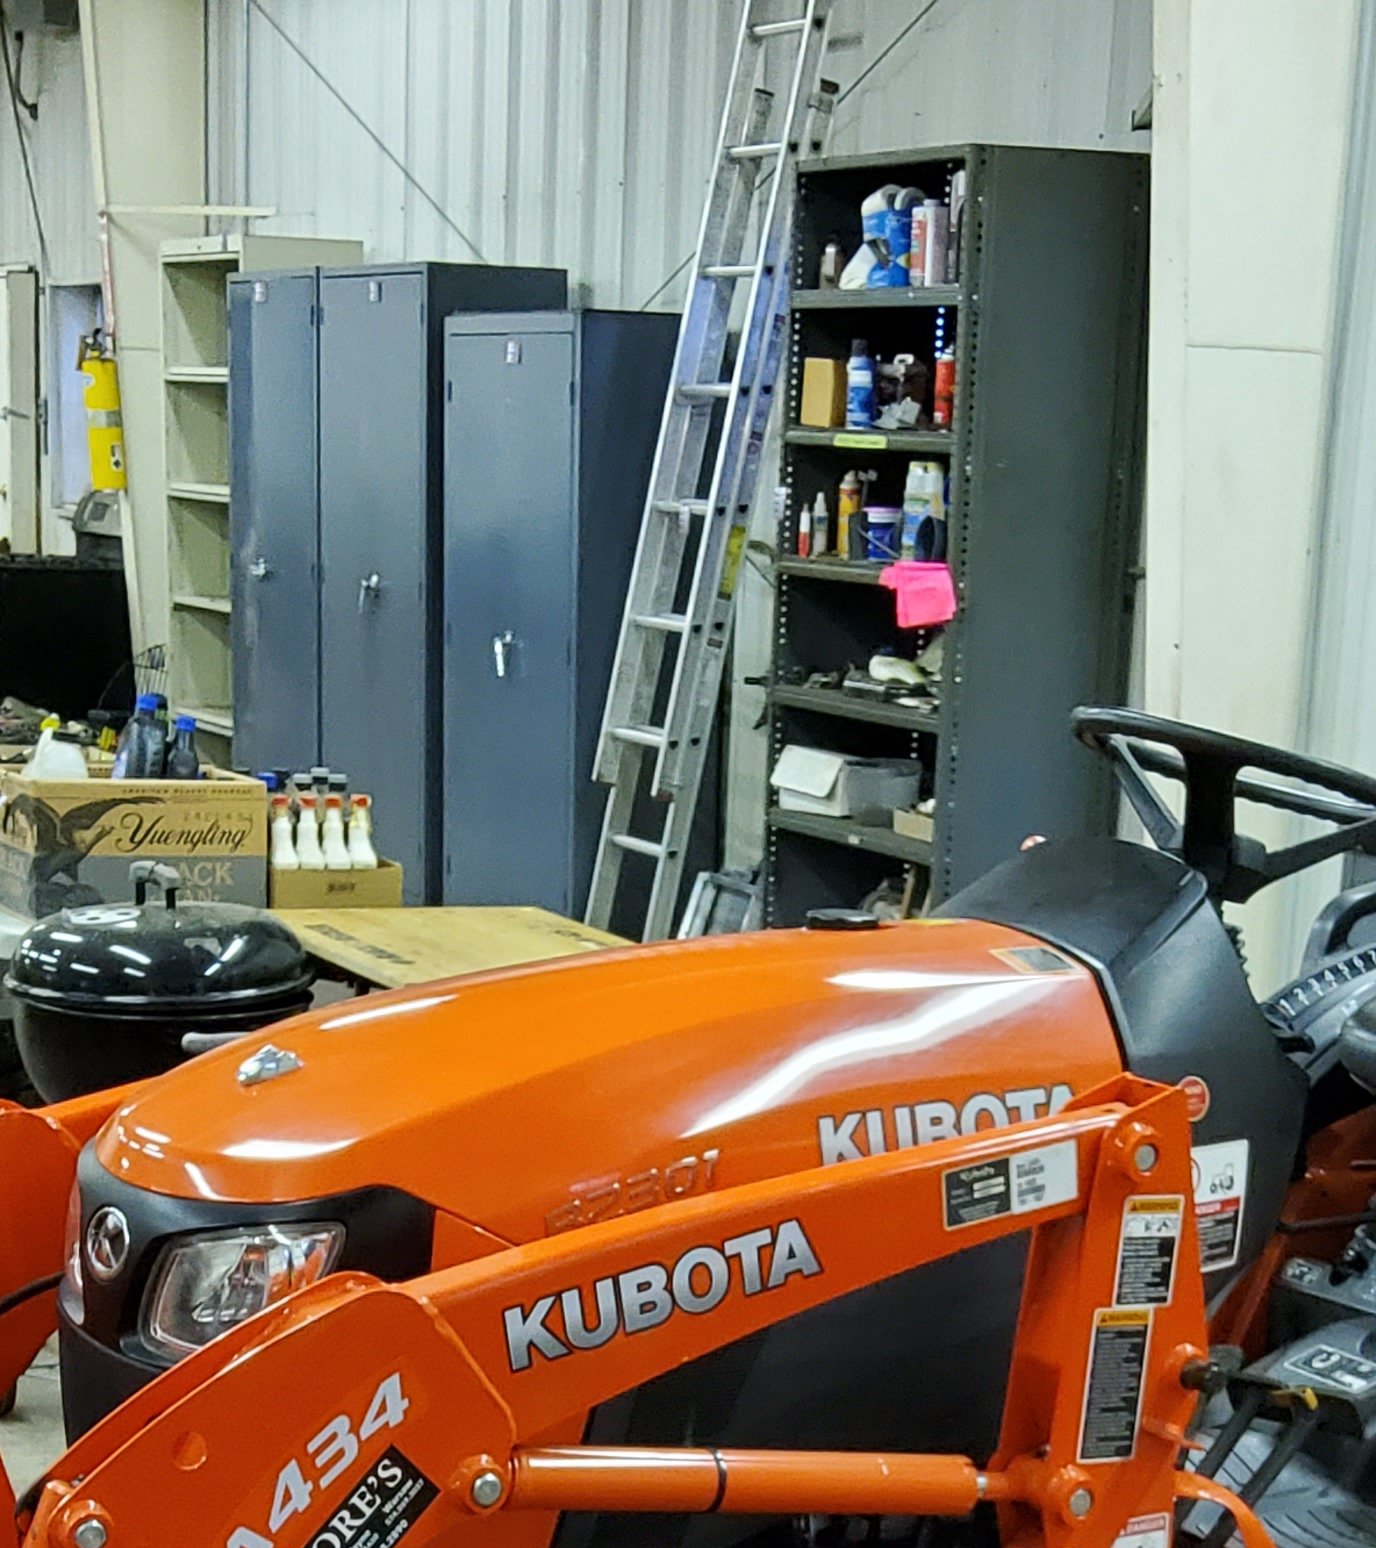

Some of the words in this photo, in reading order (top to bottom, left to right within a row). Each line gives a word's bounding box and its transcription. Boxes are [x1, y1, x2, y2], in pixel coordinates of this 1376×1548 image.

[113, 812, 253, 853] Yuengling
[179, 860, 235, 887] ACK
[503, 1217, 823, 1373] KUBOTA
[381, 1476, 415, 1515] Warsaw
